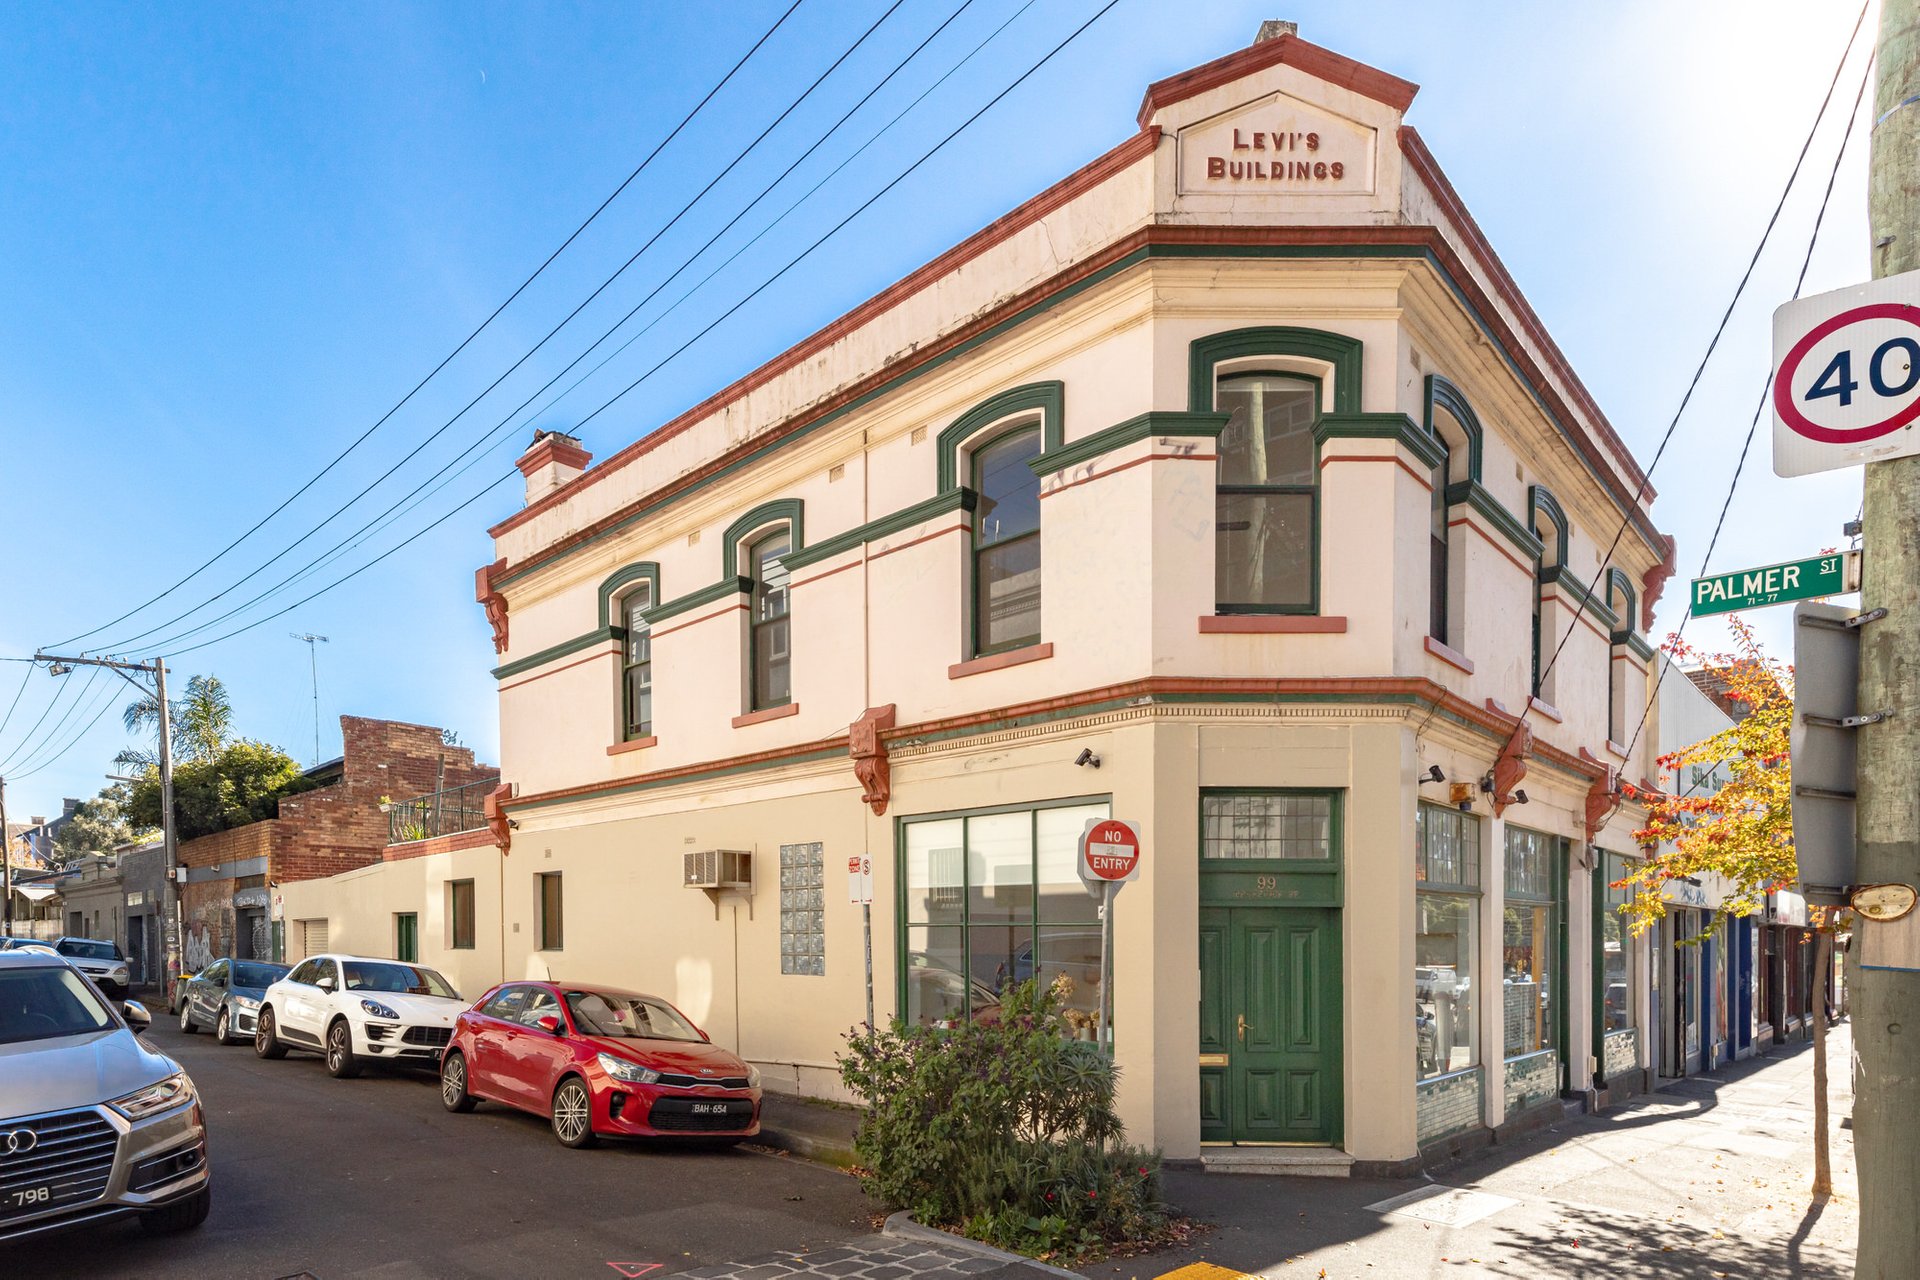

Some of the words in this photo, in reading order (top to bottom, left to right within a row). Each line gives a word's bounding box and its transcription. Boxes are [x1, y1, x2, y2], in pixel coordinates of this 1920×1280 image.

[1233, 128, 1320, 150] LEVI'S
[1207, 156, 1345, 179] BUILDINGS
[1804, 336, 1920, 407] 40
[1697, 565, 1801, 605] PALMER
[1820, 558, 1838, 573] ST
[1104, 830, 1122, 842] NO
[1093, 857, 1131, 871] ENTRY
[1257, 876, 1276, 890] 99
